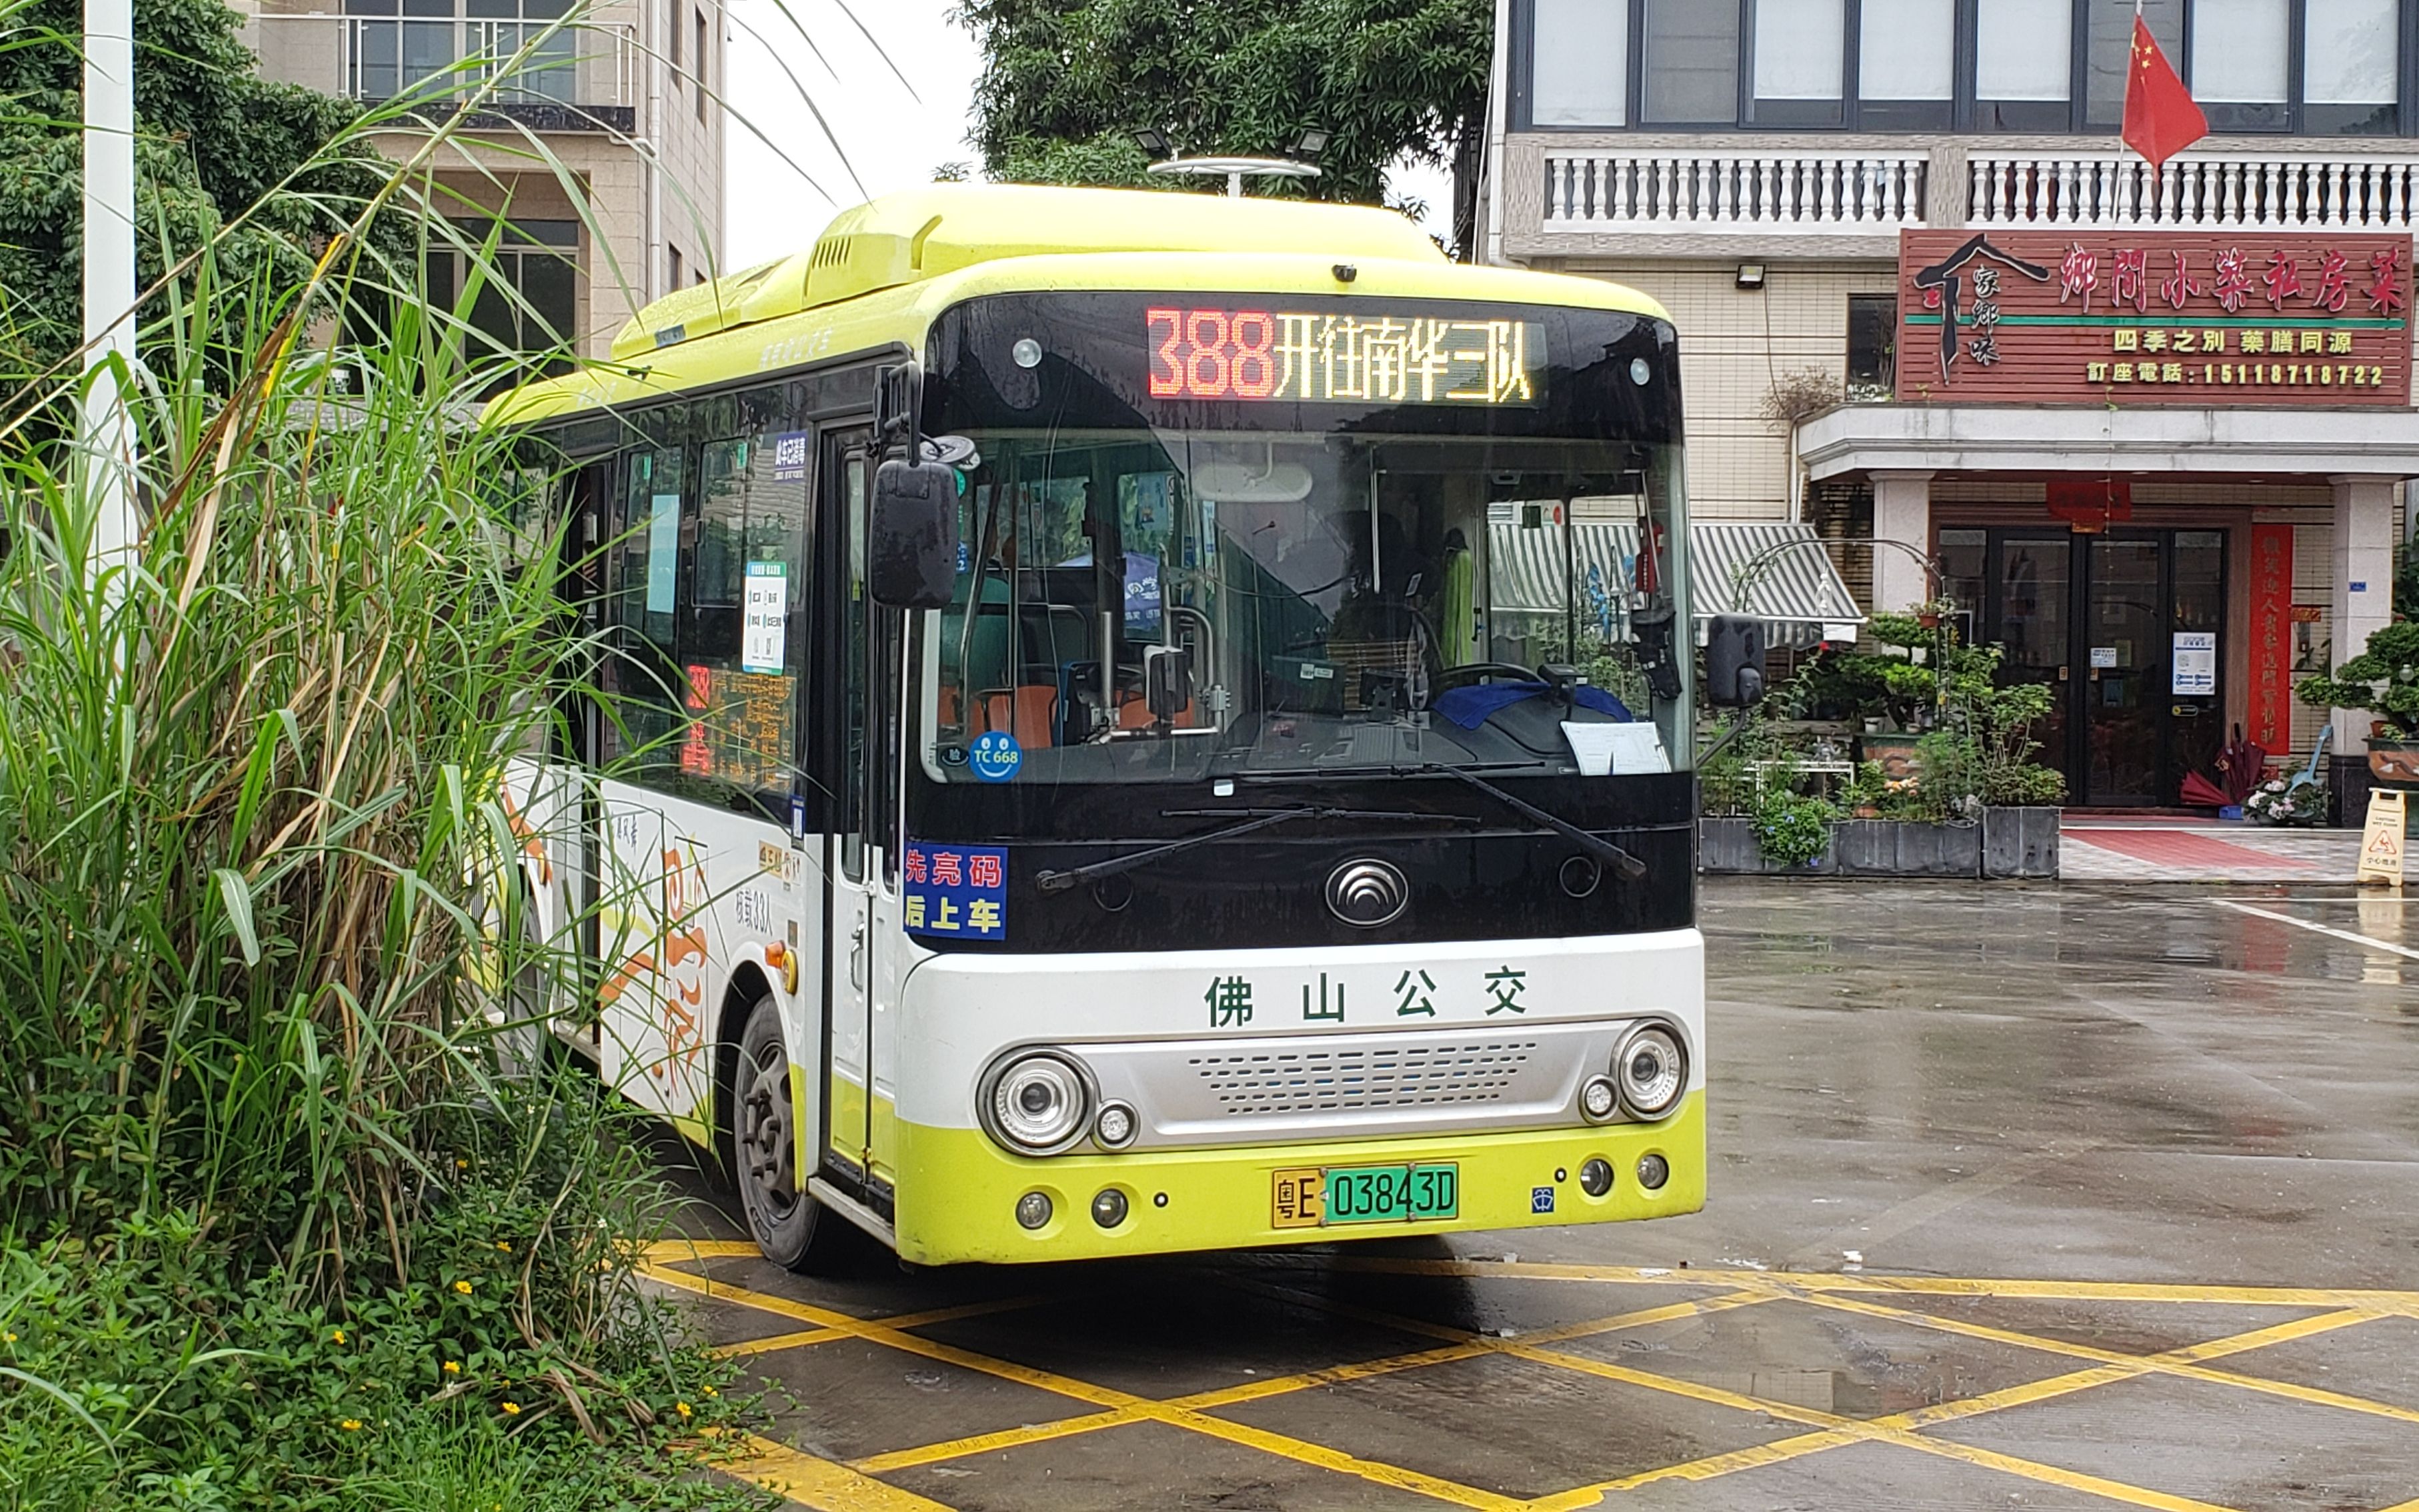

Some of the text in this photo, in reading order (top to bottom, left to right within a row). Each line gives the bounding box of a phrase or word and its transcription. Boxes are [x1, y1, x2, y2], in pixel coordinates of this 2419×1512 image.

[1147, 306, 1532, 403] 388 开往南华三队
[2240, 330, 2353, 354] 藥膳同源
[974, 749, 1019, 764] TC 668
[905, 849, 1002, 888] 先亮码
[905, 895, 1001, 933] 后上车
[1204, 965, 1528, 1028] 佛山公交
[1276, 1169, 1455, 1219] 粤E 03843D
